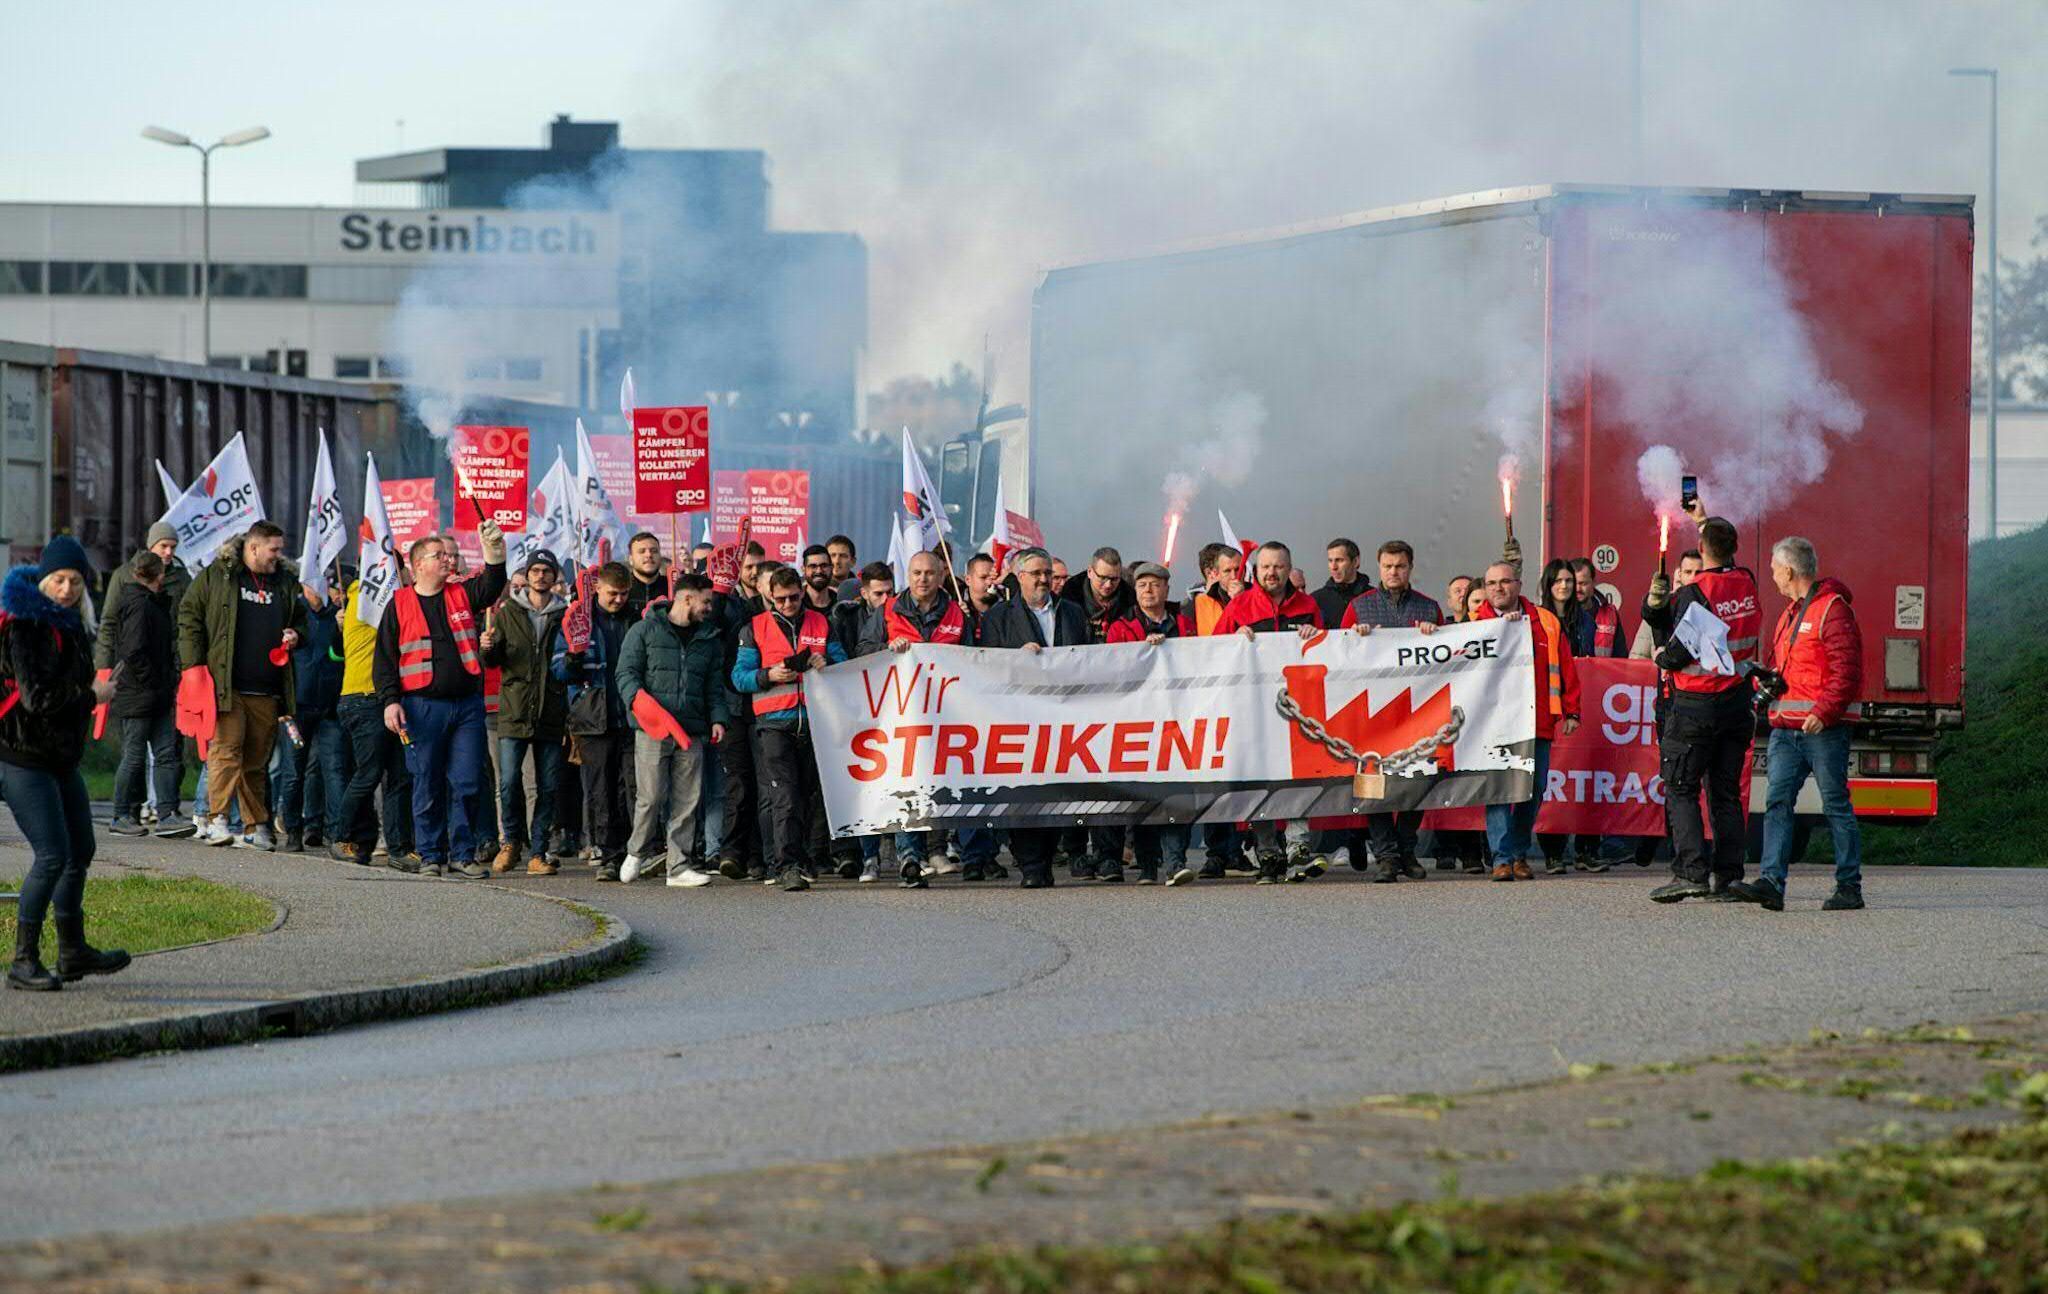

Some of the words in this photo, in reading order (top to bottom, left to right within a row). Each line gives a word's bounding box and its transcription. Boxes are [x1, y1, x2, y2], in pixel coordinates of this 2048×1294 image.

[340, 213, 595, 252] Steinbach
[638, 427, 658, 437] WIR
[638, 437, 686, 448] KÄMPFEN
[639, 448, 659, 459] FÜR
[660, 448, 706, 458] UNSEREN
[639, 460, 696, 470] KOLLEKTIV-
[462, 467, 478, 477] ÜR
[479, 468, 525, 478] UNSEREN
[639, 471, 687, 481] VERTRAG!
[751, 486, 767, 495] WIR
[676, 489, 705, 505] gpa
[752, 496, 790, 505] KÄMPFEN
[752, 504, 767, 514] FÜR
[768, 506, 806, 515] UNSEREN
[493, 509, 523, 526] gpa
[751, 516, 797, 525] KOLLEKTIV-
[751, 525, 790, 534] VERTRAG!
[780, 543, 797, 556] gp
[1597, 549, 1615, 564] 90
[1716, 595, 1756, 616] PRO-GE
[1397, 638, 1499, 666] PRO-GE
[862, 662, 961, 719] Wir
[846, 716, 1231, 783] STREIKEN!
